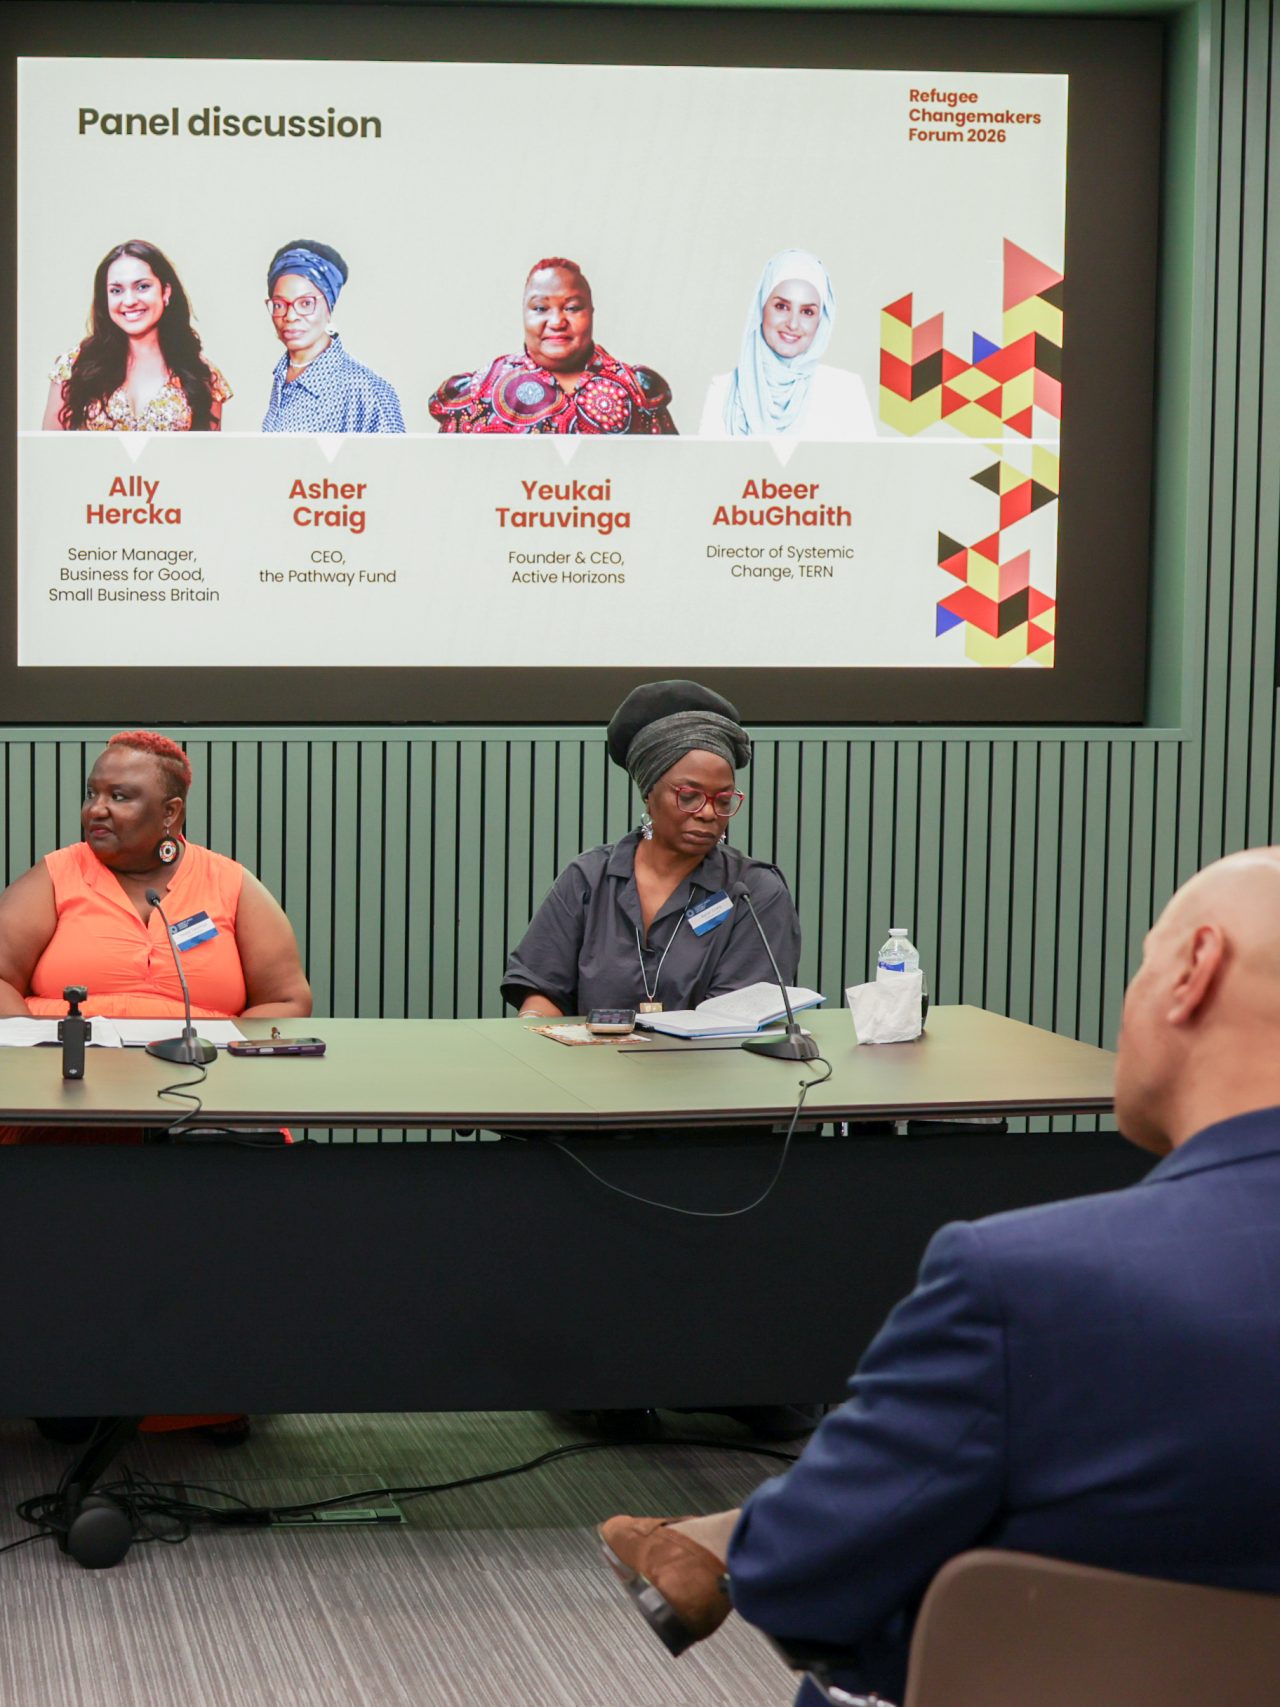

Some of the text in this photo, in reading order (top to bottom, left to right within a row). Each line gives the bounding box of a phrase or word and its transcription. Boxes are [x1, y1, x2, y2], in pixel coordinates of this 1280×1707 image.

[910, 88, 978, 107] Refugee
[79, 106, 381, 138] Panel discussion
[909, 108, 1041, 127] Changemakers
[909, 128, 1006, 142] Forum 2026
[109, 476, 159, 506] Ally
[289, 479, 366, 499] Asher
[522, 479, 610, 500] Yeukai
[742, 479, 819, 499] Abeer
[87, 502, 181, 524] Hercka
[294, 505, 365, 534] Craig
[496, 506, 630, 535] Taruvinga
[713, 504, 851, 526] AbuGhaith
[69, 547, 196, 565] Senior Manager,
[311, 551, 345, 565] CEO,
[509, 551, 624, 565] Founder & CEO,
[707, 545, 854, 562] Director of Systemic
[61, 567, 204, 582] Business for Good,
[260, 570, 396, 586] the Pathway Fund
[512, 570, 625, 583] Active Horizons
[731, 565, 833, 581] Change, TERN
[49, 588, 219, 601] Small Business Britain
